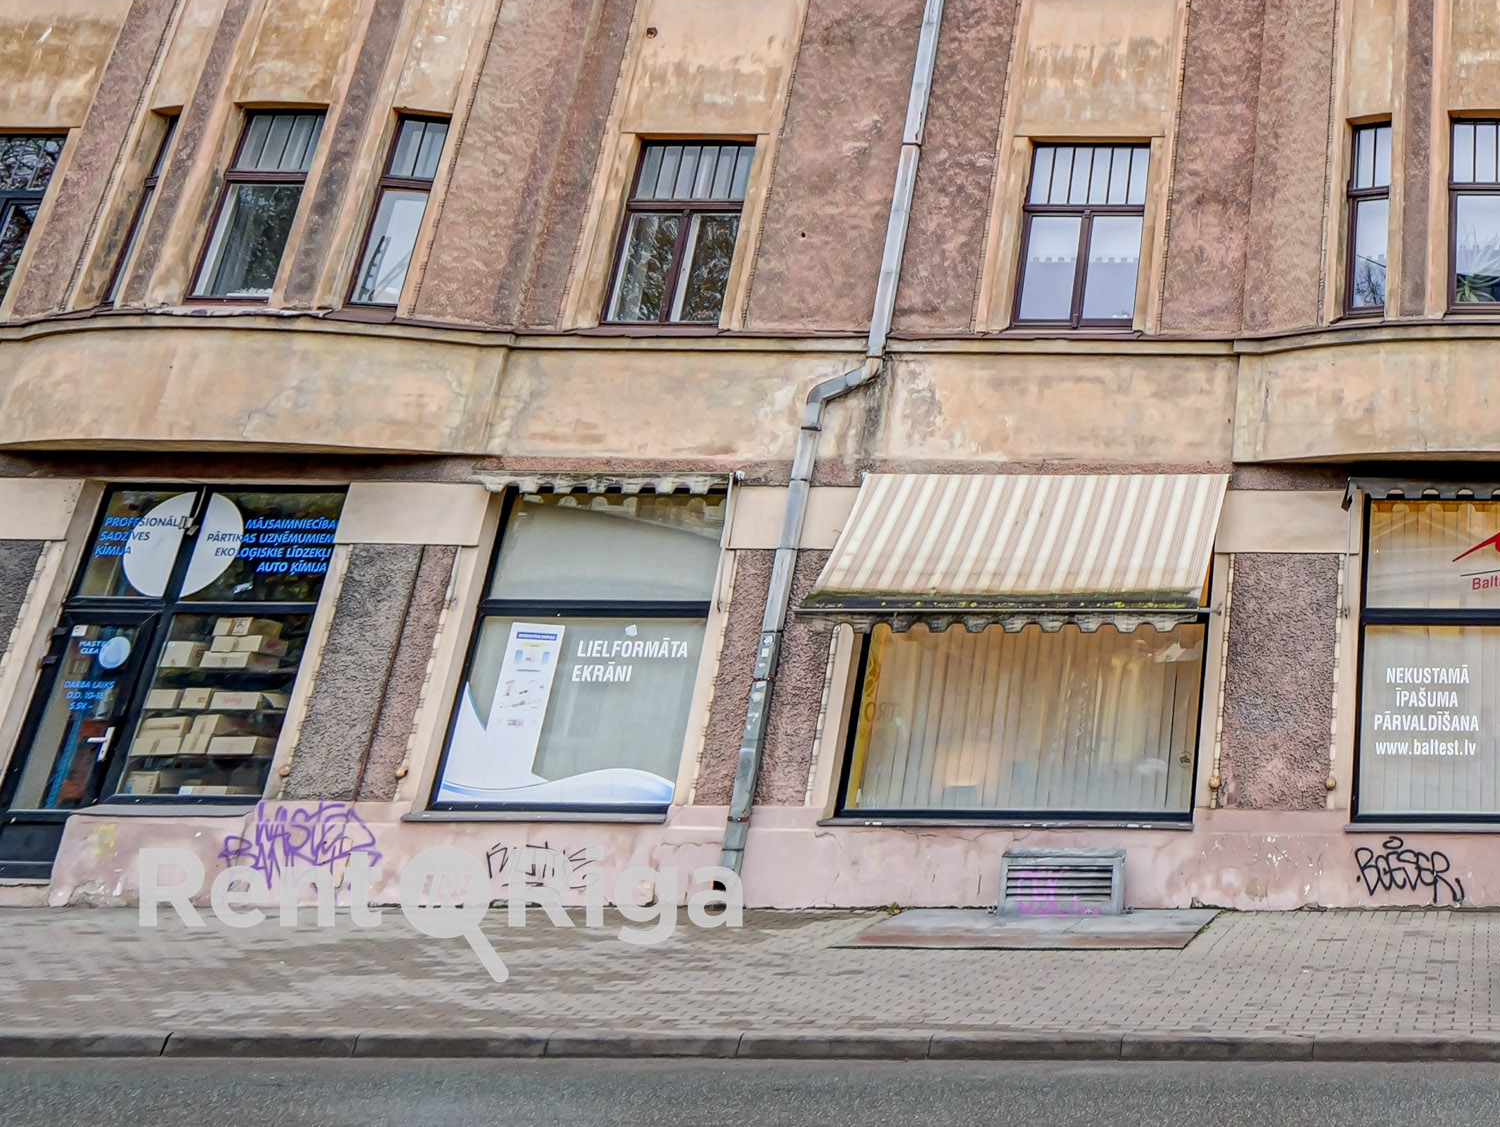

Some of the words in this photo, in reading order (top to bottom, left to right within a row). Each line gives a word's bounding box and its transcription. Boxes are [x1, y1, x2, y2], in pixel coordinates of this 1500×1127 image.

[104, 515, 191, 528] PROFESIONĀL
[206, 531, 257, 544] PĀRTIKAS
[94, 543, 131, 558] ĶĪMIJA
[214, 547, 283, 561] EKOLOĢISKIE
[285, 545, 332, 561] LĪDZEKĻI
[256, 561, 288, 573] AUTO
[290, 559, 328, 576] ĶĪMIJA
[577, 637, 688, 658] LIELFORMĀTA
[571, 661, 633, 682] EKRĀNI
[1386, 664, 1469, 684] NEKUSTAMĀ
[1395, 687, 1459, 707] ĪPAŠUMA
[1374, 711, 1479, 731] PĀRVALDĪŠANA
[1375, 739, 1476, 756] www.baltest.lv
